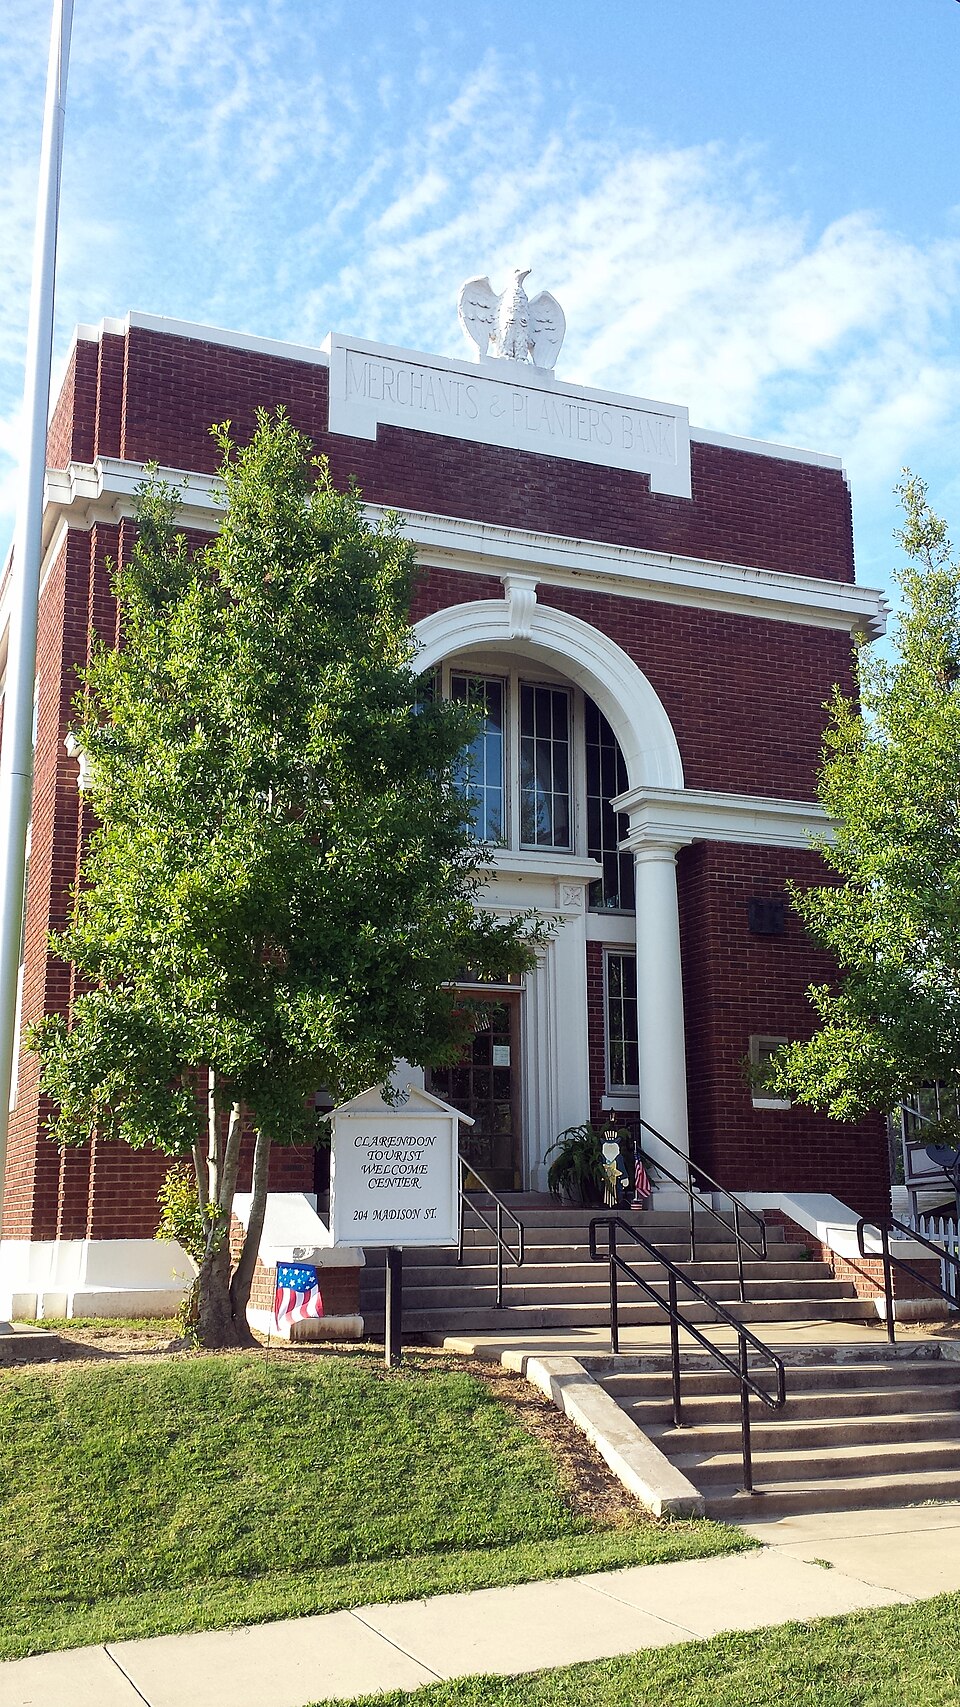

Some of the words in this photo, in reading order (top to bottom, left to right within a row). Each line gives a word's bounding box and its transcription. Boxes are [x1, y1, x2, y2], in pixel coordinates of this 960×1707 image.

[349, 358, 479, 419] MERCHANTS
[489, 394, 506, 418] &
[512, 392, 613, 446] PLANTERS
[622, 414, 673, 458] BANK
[353, 1136, 437, 1148] CLARENDON
[367, 1150, 424, 1162] TOURIST
[361, 1164, 428, 1175] WELCOME
[368, 1177, 422, 1189] CENTER
[353, 1210, 368, 1221] 204
[372, 1209, 421, 1221] MADISON
[424, 1208, 437, 1219] ST.
